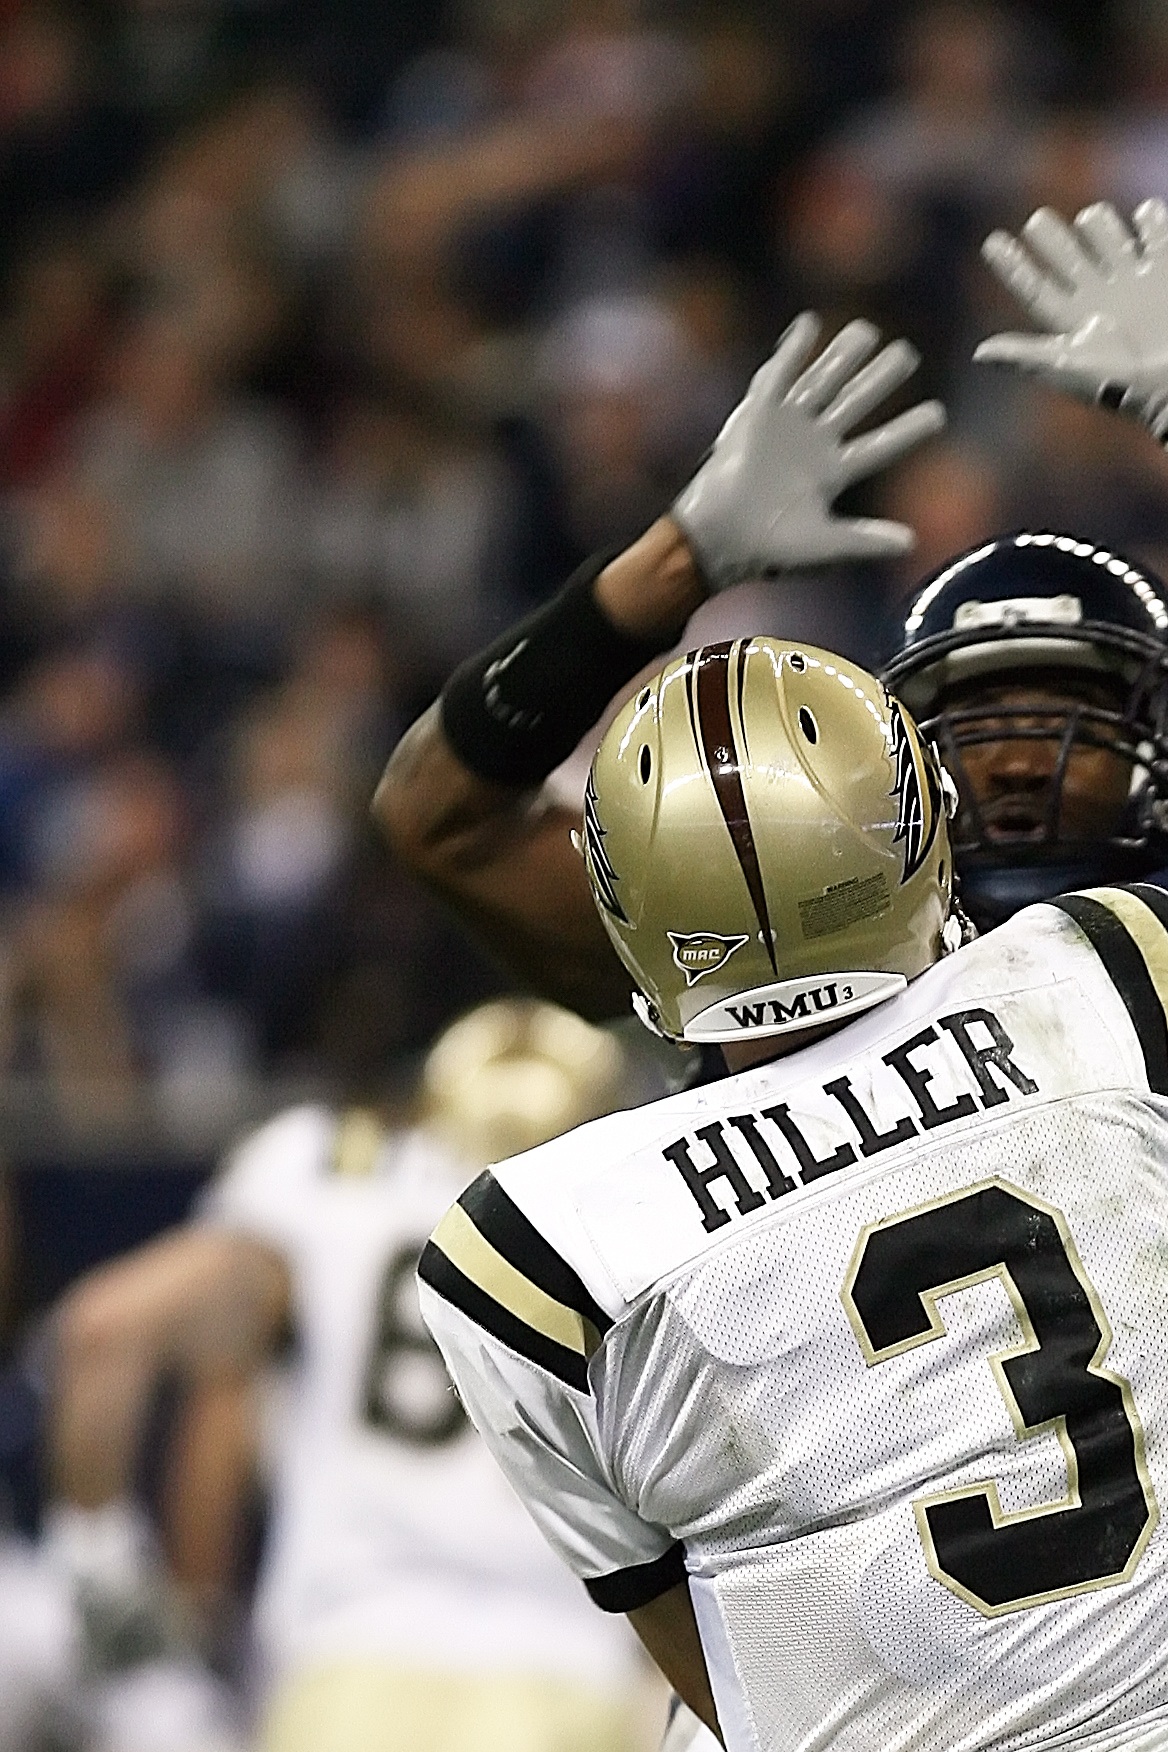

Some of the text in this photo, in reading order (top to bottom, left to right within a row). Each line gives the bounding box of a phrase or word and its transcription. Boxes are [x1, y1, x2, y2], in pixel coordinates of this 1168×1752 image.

[724, 982, 854, 1028] WMU 3
[662, 1008, 1039, 1233] HILLER
[839, 1174, 1160, 1618] 3
